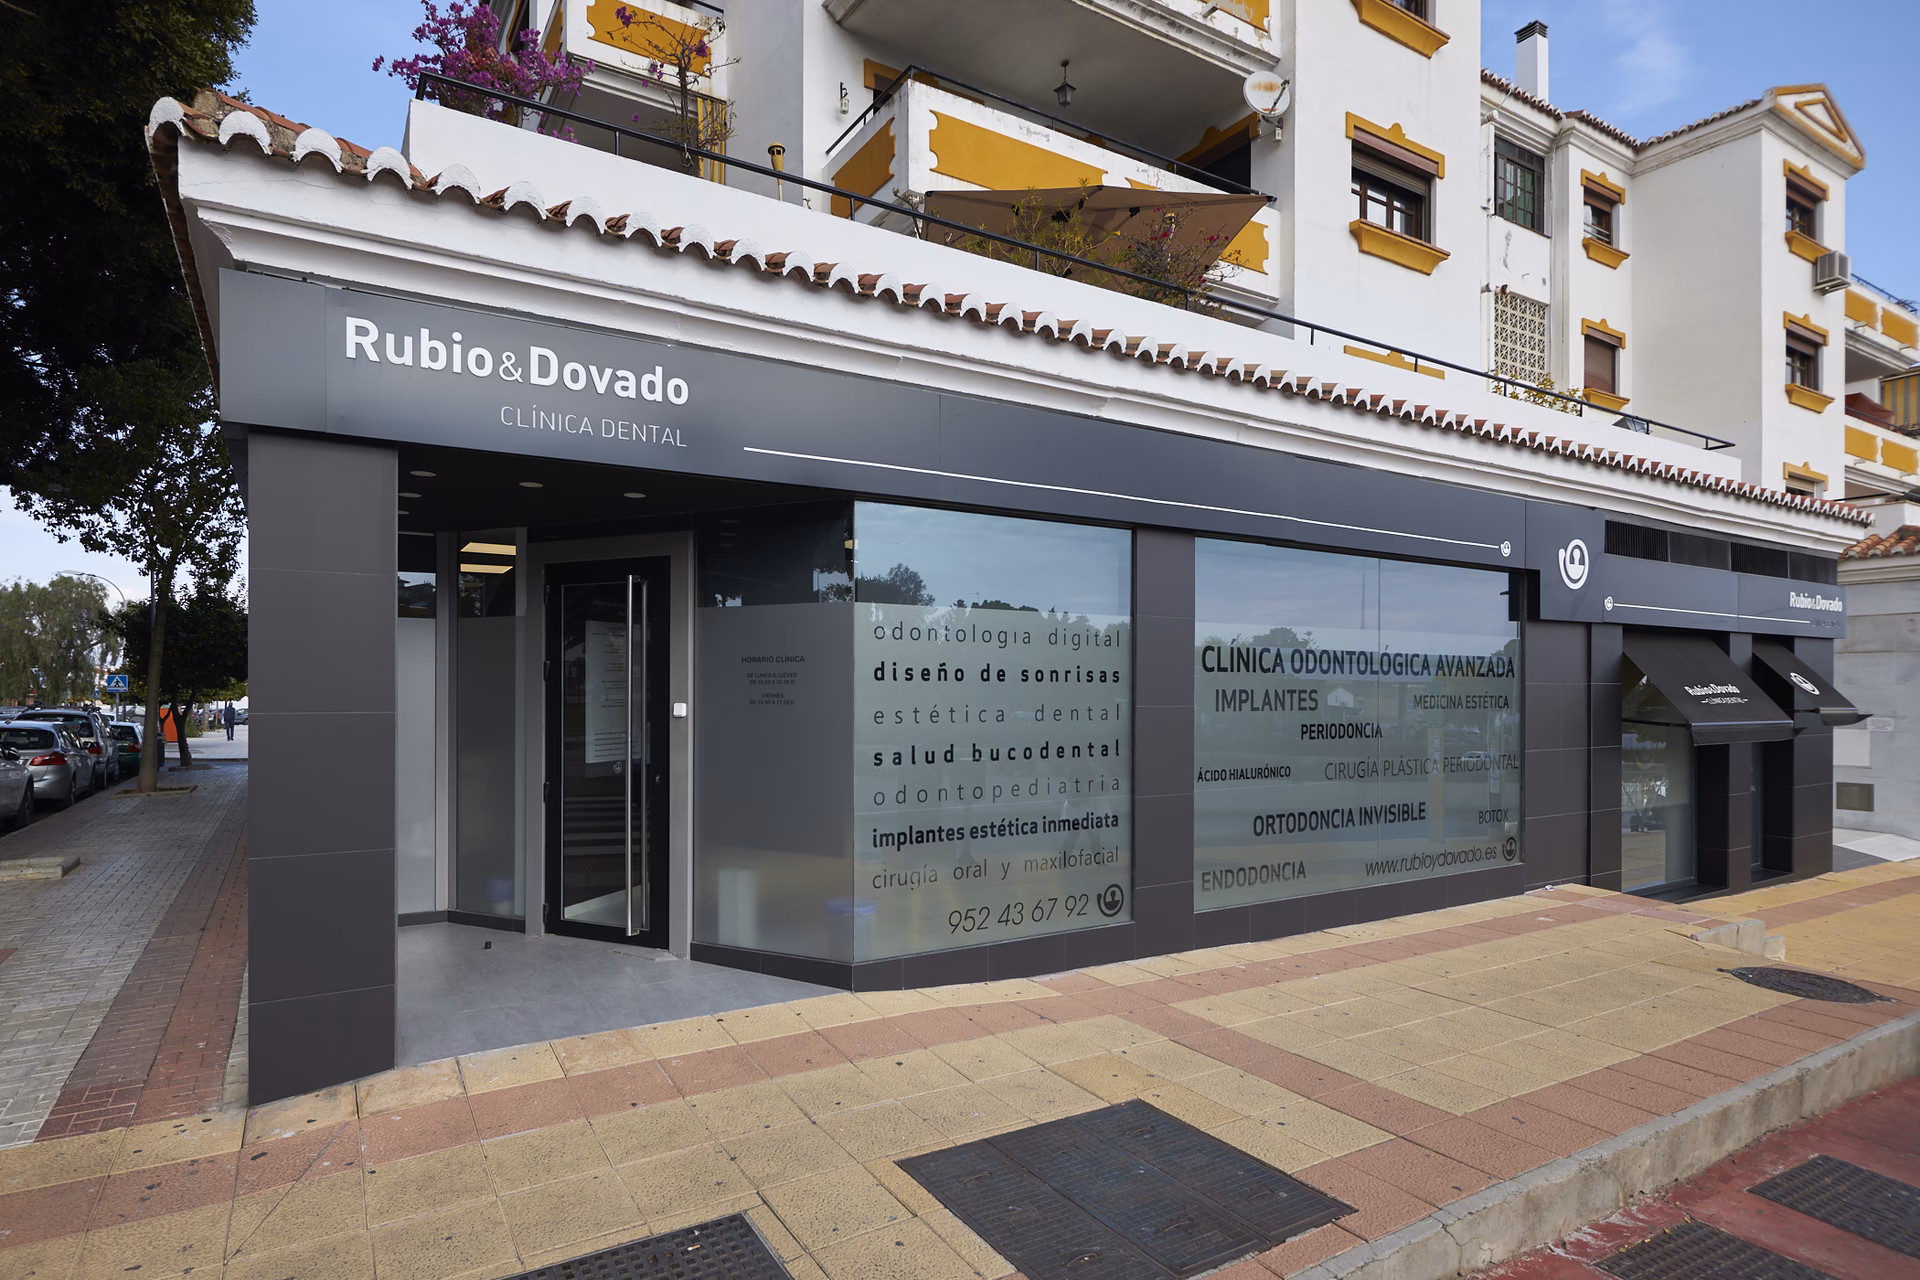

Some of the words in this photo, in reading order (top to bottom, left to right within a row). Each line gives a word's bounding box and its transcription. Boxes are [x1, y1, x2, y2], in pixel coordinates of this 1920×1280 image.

[345, 316, 690, 405] Rubio&Dovado
[500, 404, 593, 436] CLÍNICA
[602, 418, 688, 448] DENTAL
[1789, 591, 1843, 612] Rubio&Dovado
[1048, 627, 1120, 651] digital
[775, 654, 805, 663] CLÍNICA
[873, 661, 965, 682] diseño
[980, 663, 1006, 683] de
[1020, 665, 1120, 684] sonrisas
[1201, 638, 1286, 674] CLÍNICA
[1290, 644, 1431, 677] ODONTOLÓGICA
[1435, 654, 1516, 679] AVANZADA
[873, 704, 1005, 724] estética
[1034, 703, 1120, 722] dental
[1214, 688, 1319, 713] IMPLANTES
[1413, 694, 1464, 710] MEDICINA
[1465, 690, 1510, 710] ESTÉTICA
[1300, 722, 1383, 741] PERIODONCIA
[873, 743, 955, 767] salud
[972, 739, 1120, 762] bucodental
[1324, 755, 1379, 781] CIRUGÍA
[1383, 753, 1440, 777] PLÁSTICA
[1443, 754, 1519, 774] PERIODONTAL
[1197, 766, 1228, 783] ÁCIDO
[1229, 762, 1291, 781] HIALURÓNICO
[873, 777, 1120, 805] odontopediatria
[1252, 807, 1356, 837] ORTODONCIA
[1359, 801, 1427, 827] INVISIBLE
[1478, 808, 1509, 825] BOTOX
[872, 826, 965, 851] implantes
[969, 817, 1038, 840] estética
[1042, 811, 1119, 834] inmediata
[872, 864, 938, 890] cirugía
[953, 858, 988, 880] oral
[1000, 859, 1011, 880] y
[1024, 845, 1119, 873] maxilofacial
[1365, 845, 1498, 877] www.rubioydovado.es
[1201, 859, 1307, 893] ENDODONCIA
[948, 906, 990, 935] 952
[997, 901, 1025, 927] 43
[1031, 897, 1058, 923] 67
[1064, 893, 1090, 918] 92
